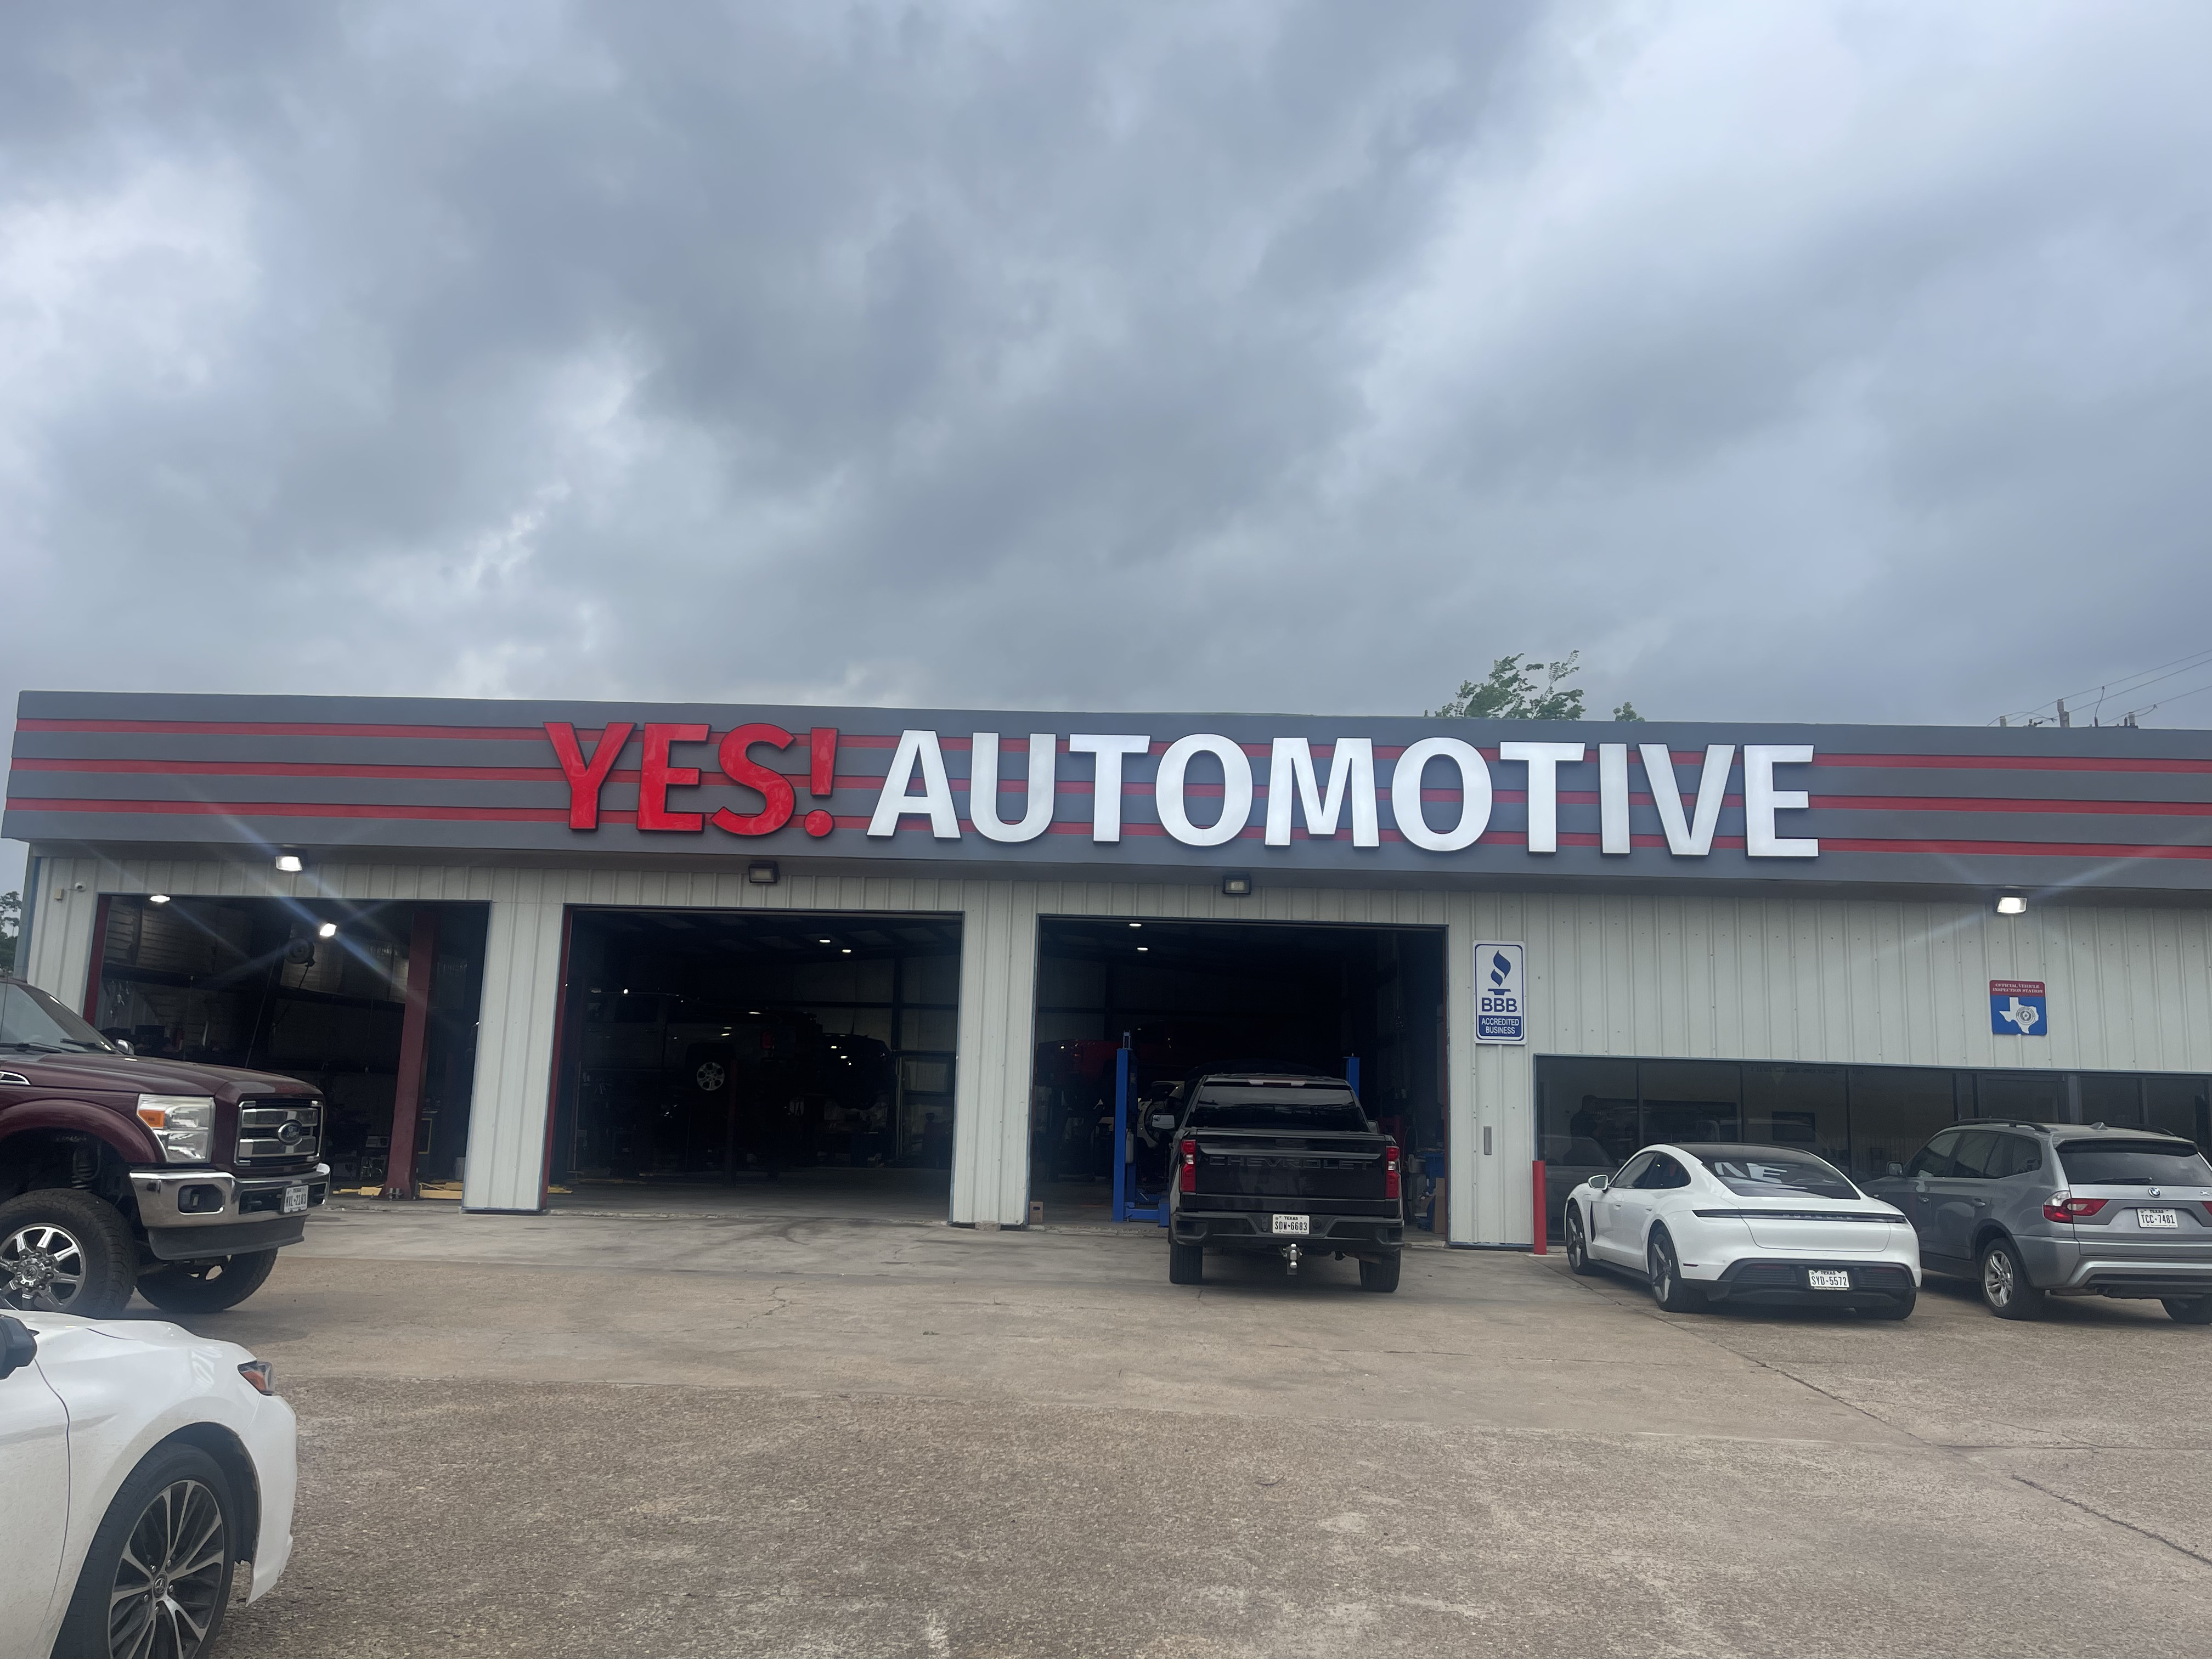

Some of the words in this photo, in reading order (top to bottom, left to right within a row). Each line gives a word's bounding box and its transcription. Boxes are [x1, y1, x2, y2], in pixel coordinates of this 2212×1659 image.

[543, 722, 839, 837] YES!
[866, 730, 1819, 857] AUTOMOTIVE
[1482, 997, 1517, 1012] BBB
[1481, 1018, 1520, 1026] ACCREDITED
[1486, 1026, 1515, 1034] BUSINESS
[1209, 1156, 1373, 1170] CHEVROLET
